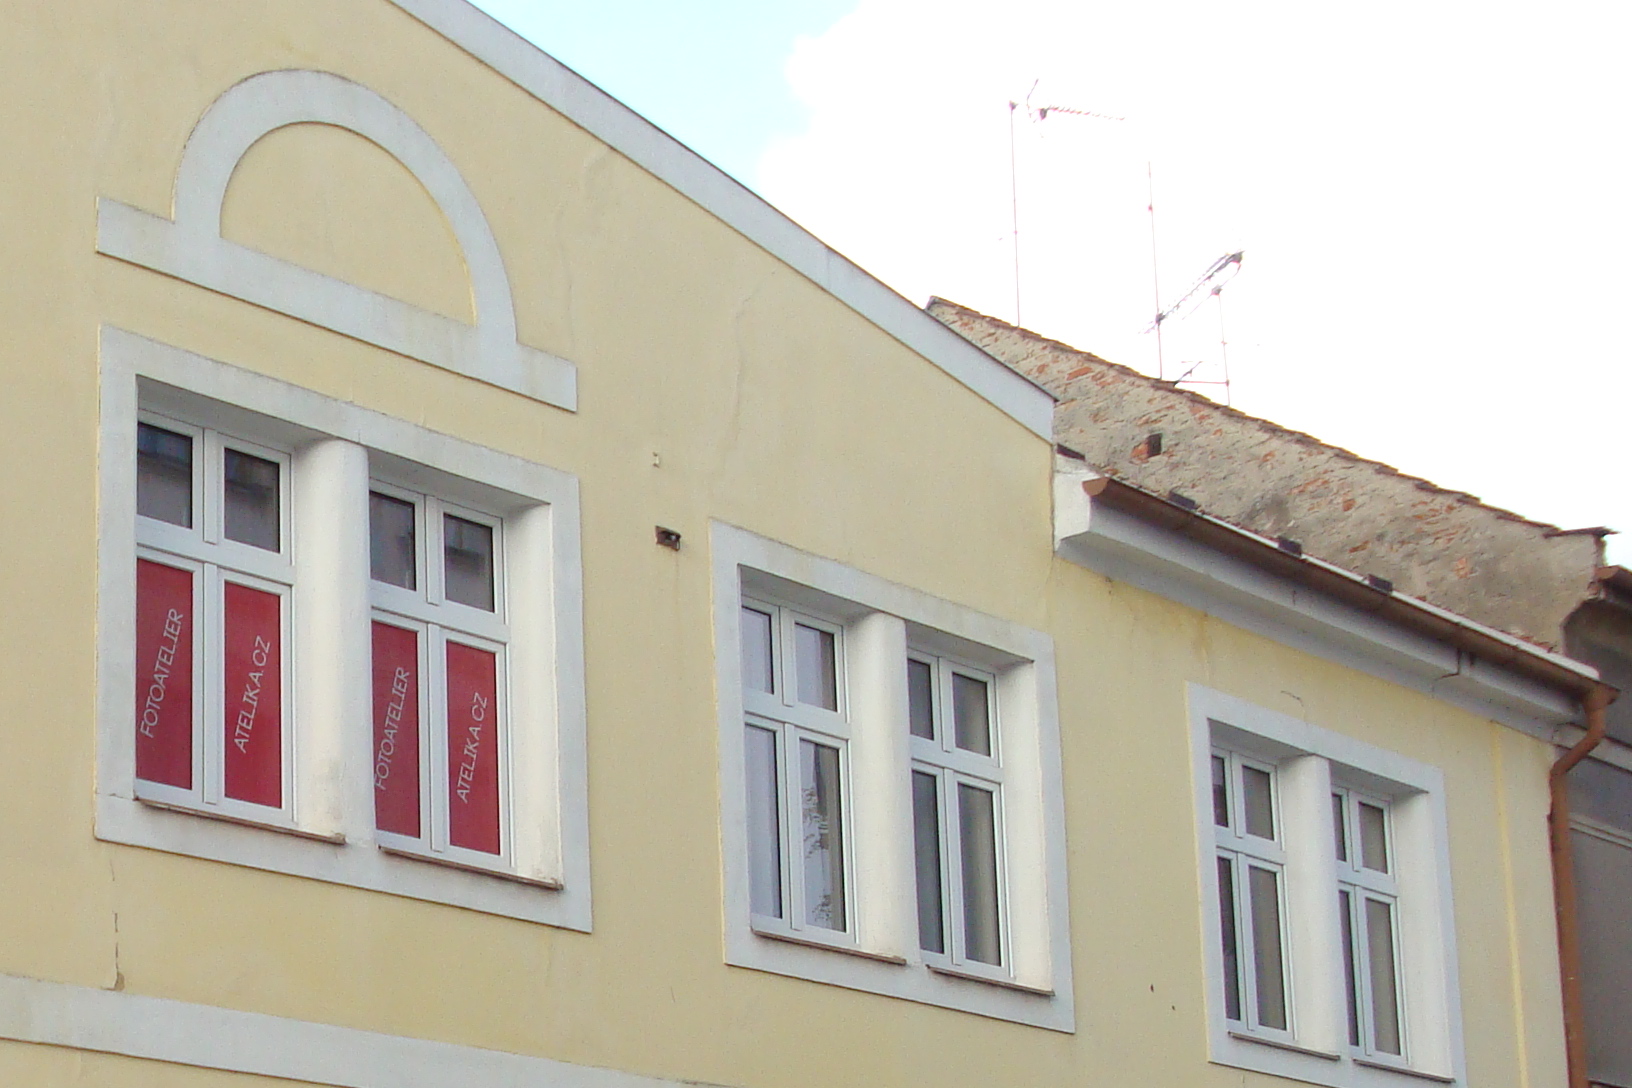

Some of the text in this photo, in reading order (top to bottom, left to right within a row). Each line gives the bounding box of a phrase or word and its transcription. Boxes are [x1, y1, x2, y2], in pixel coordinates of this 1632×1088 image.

[139, 608, 185, 739] FOTOATELIER
[234, 635, 272, 754] ATELIKA.CZ
[374, 666, 411, 791] FOTOATELIER
[456, 692, 489, 804] ATELIKA.CZ
